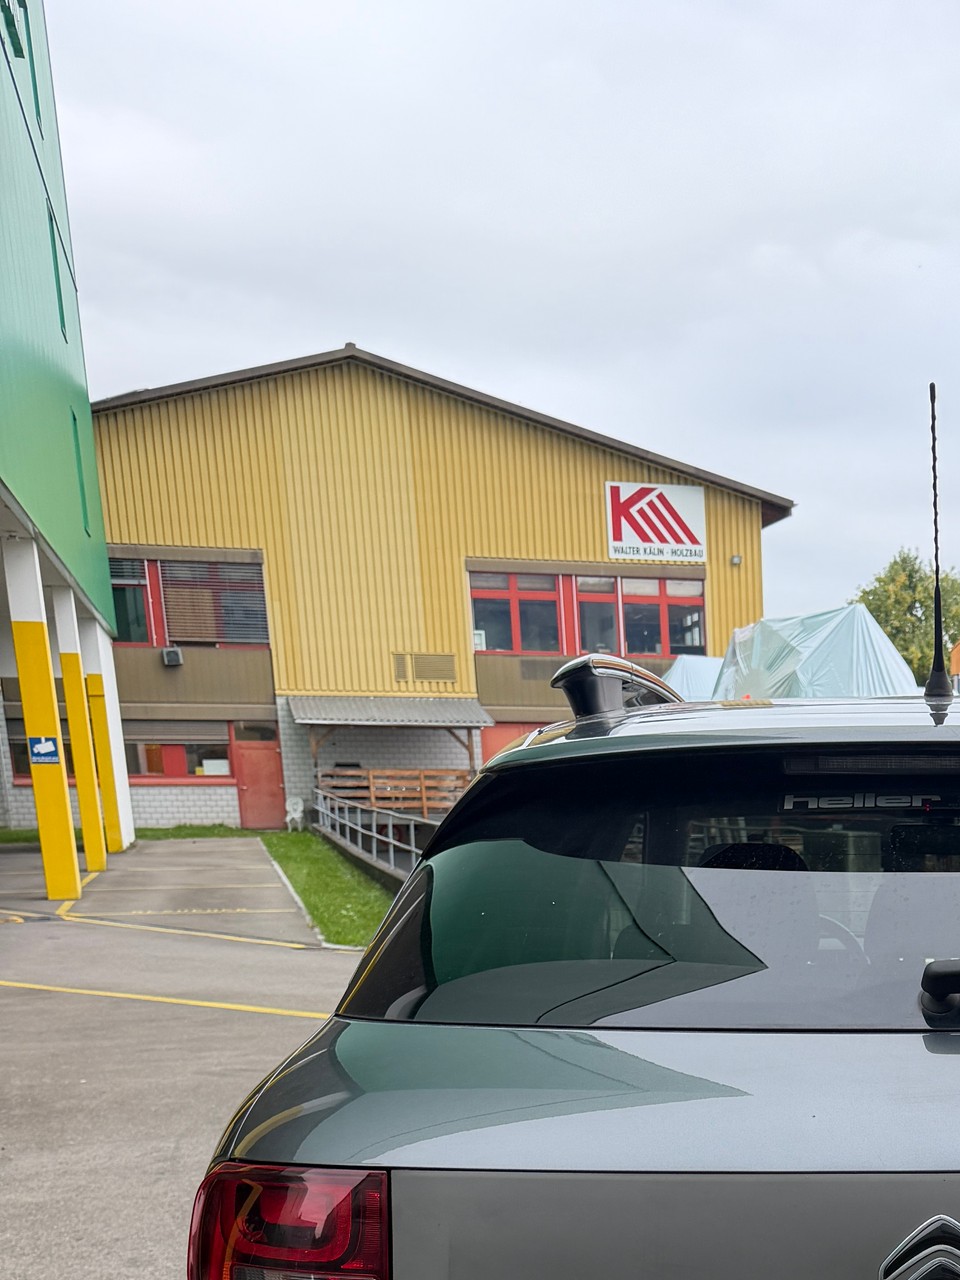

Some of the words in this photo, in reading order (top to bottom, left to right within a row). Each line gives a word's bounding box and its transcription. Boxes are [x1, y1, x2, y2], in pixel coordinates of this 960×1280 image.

[612, 546, 640, 555] WALTER
[671, 548, 704, 558] HOLZBAU
[783, 793, 941, 809] heller
